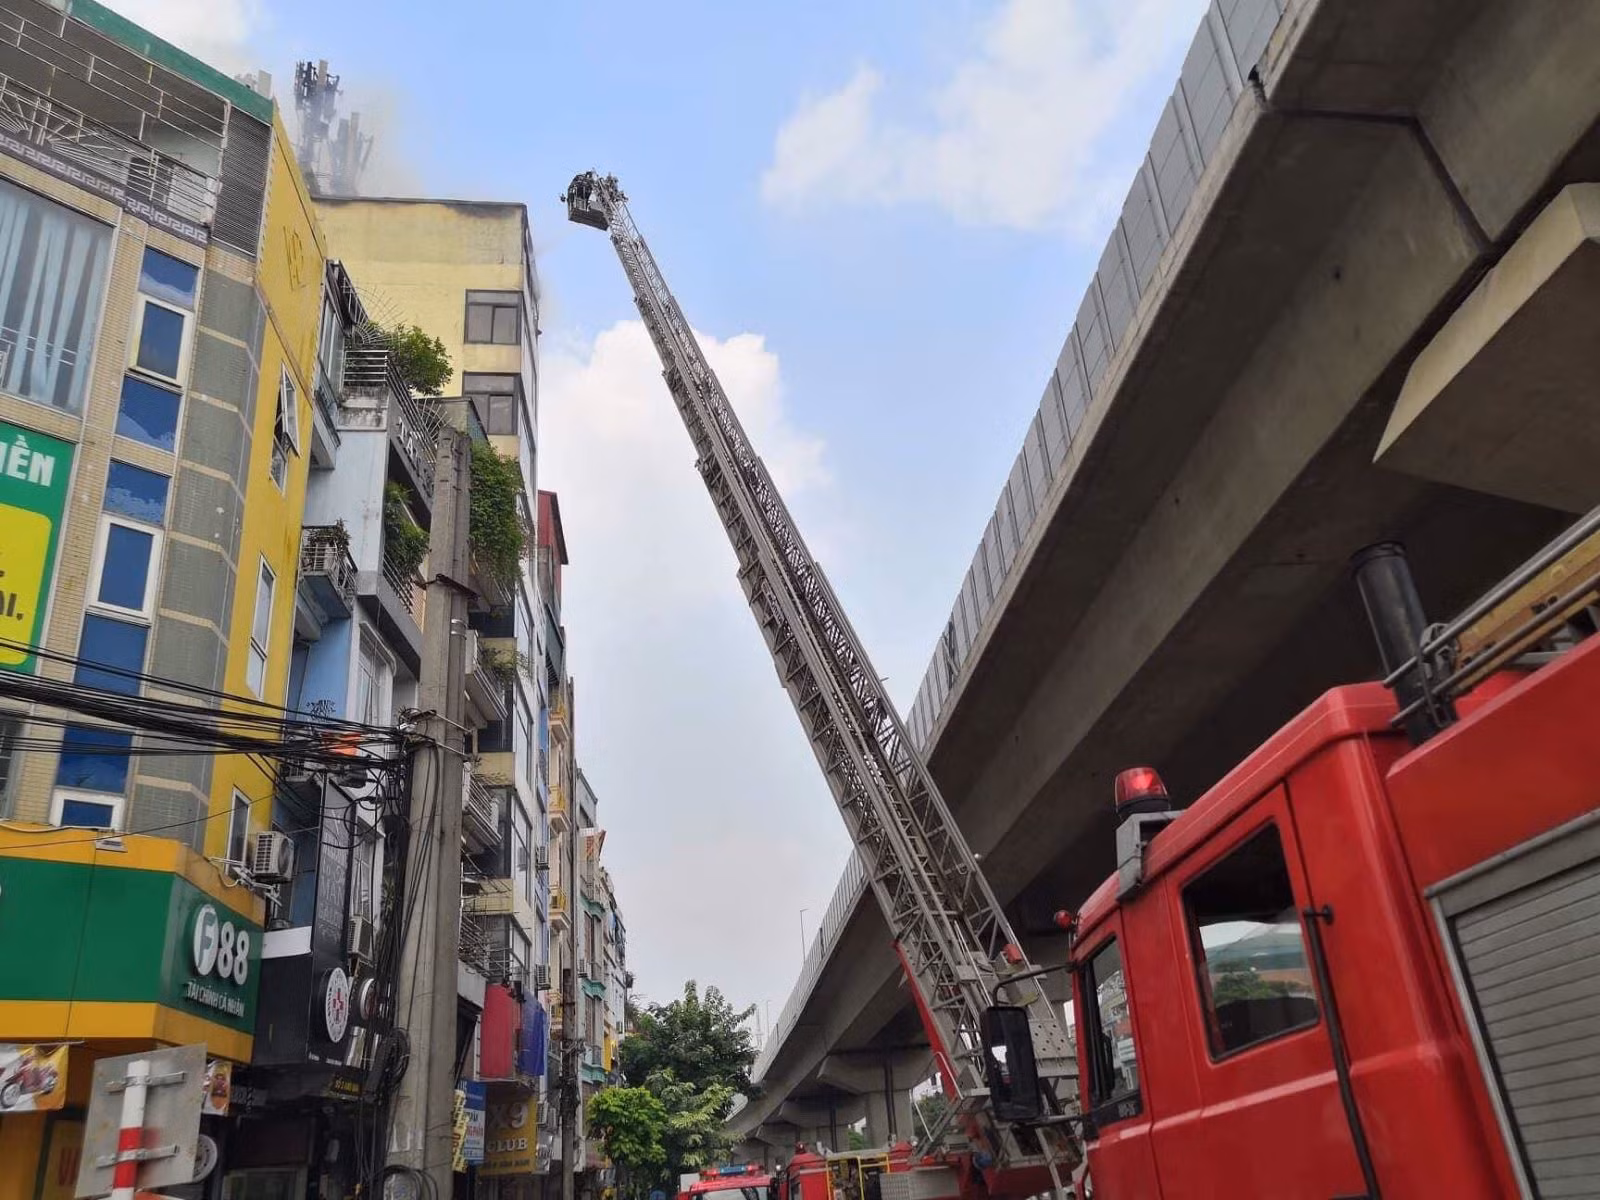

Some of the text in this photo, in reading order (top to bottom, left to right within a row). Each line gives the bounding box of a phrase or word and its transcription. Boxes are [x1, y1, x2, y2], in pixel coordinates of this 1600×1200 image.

[194, 904, 250, 986] F88
[200, 986, 218, 1007] CHÍNH
[488, 1138, 528, 1151] CLUB
